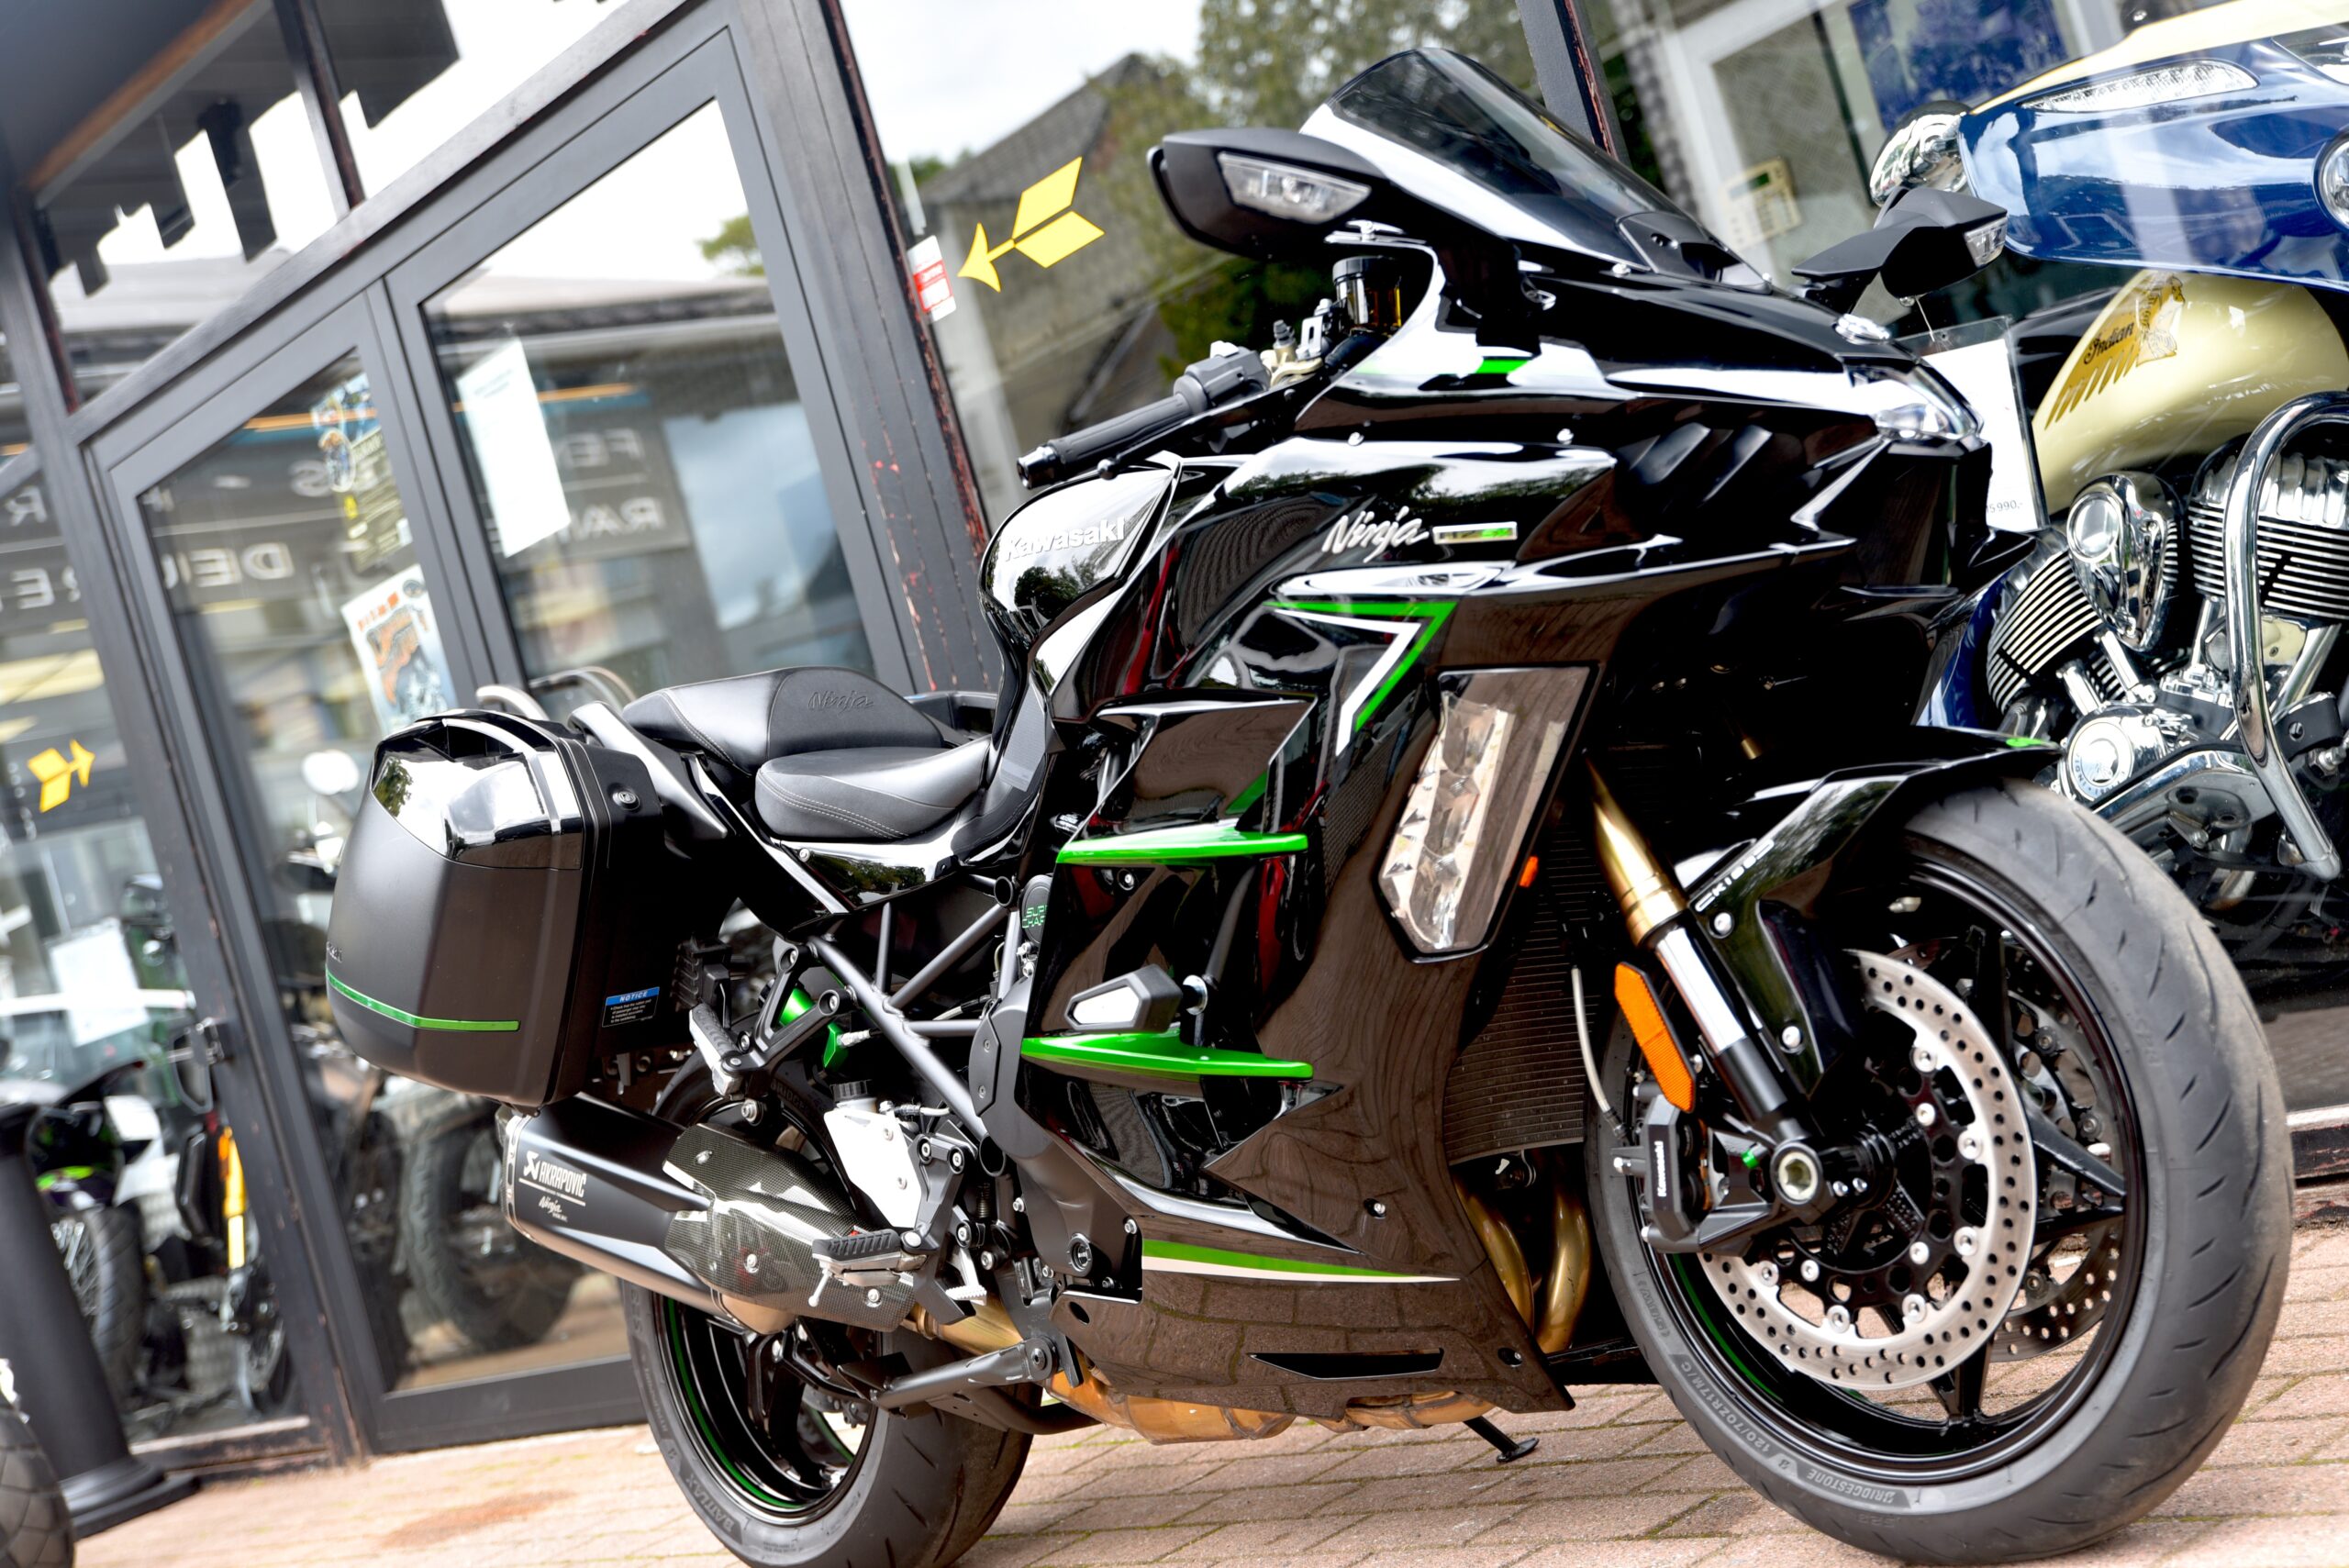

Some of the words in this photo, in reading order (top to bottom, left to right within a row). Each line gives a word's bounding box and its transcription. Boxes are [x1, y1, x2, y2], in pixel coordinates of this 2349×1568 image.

[2083, 322, 2134, 365] Indian
[1006, 517, 1125, 562] Kawasaki
[1321, 506, 1430, 563] Ninja
[808, 690, 874, 717] Ninja
[619, 991, 648, 1003] NOTICE
[686, 1473, 734, 1533] BATTLAX
[1807, 1470, 1897, 1504] BRIDGESTONE
